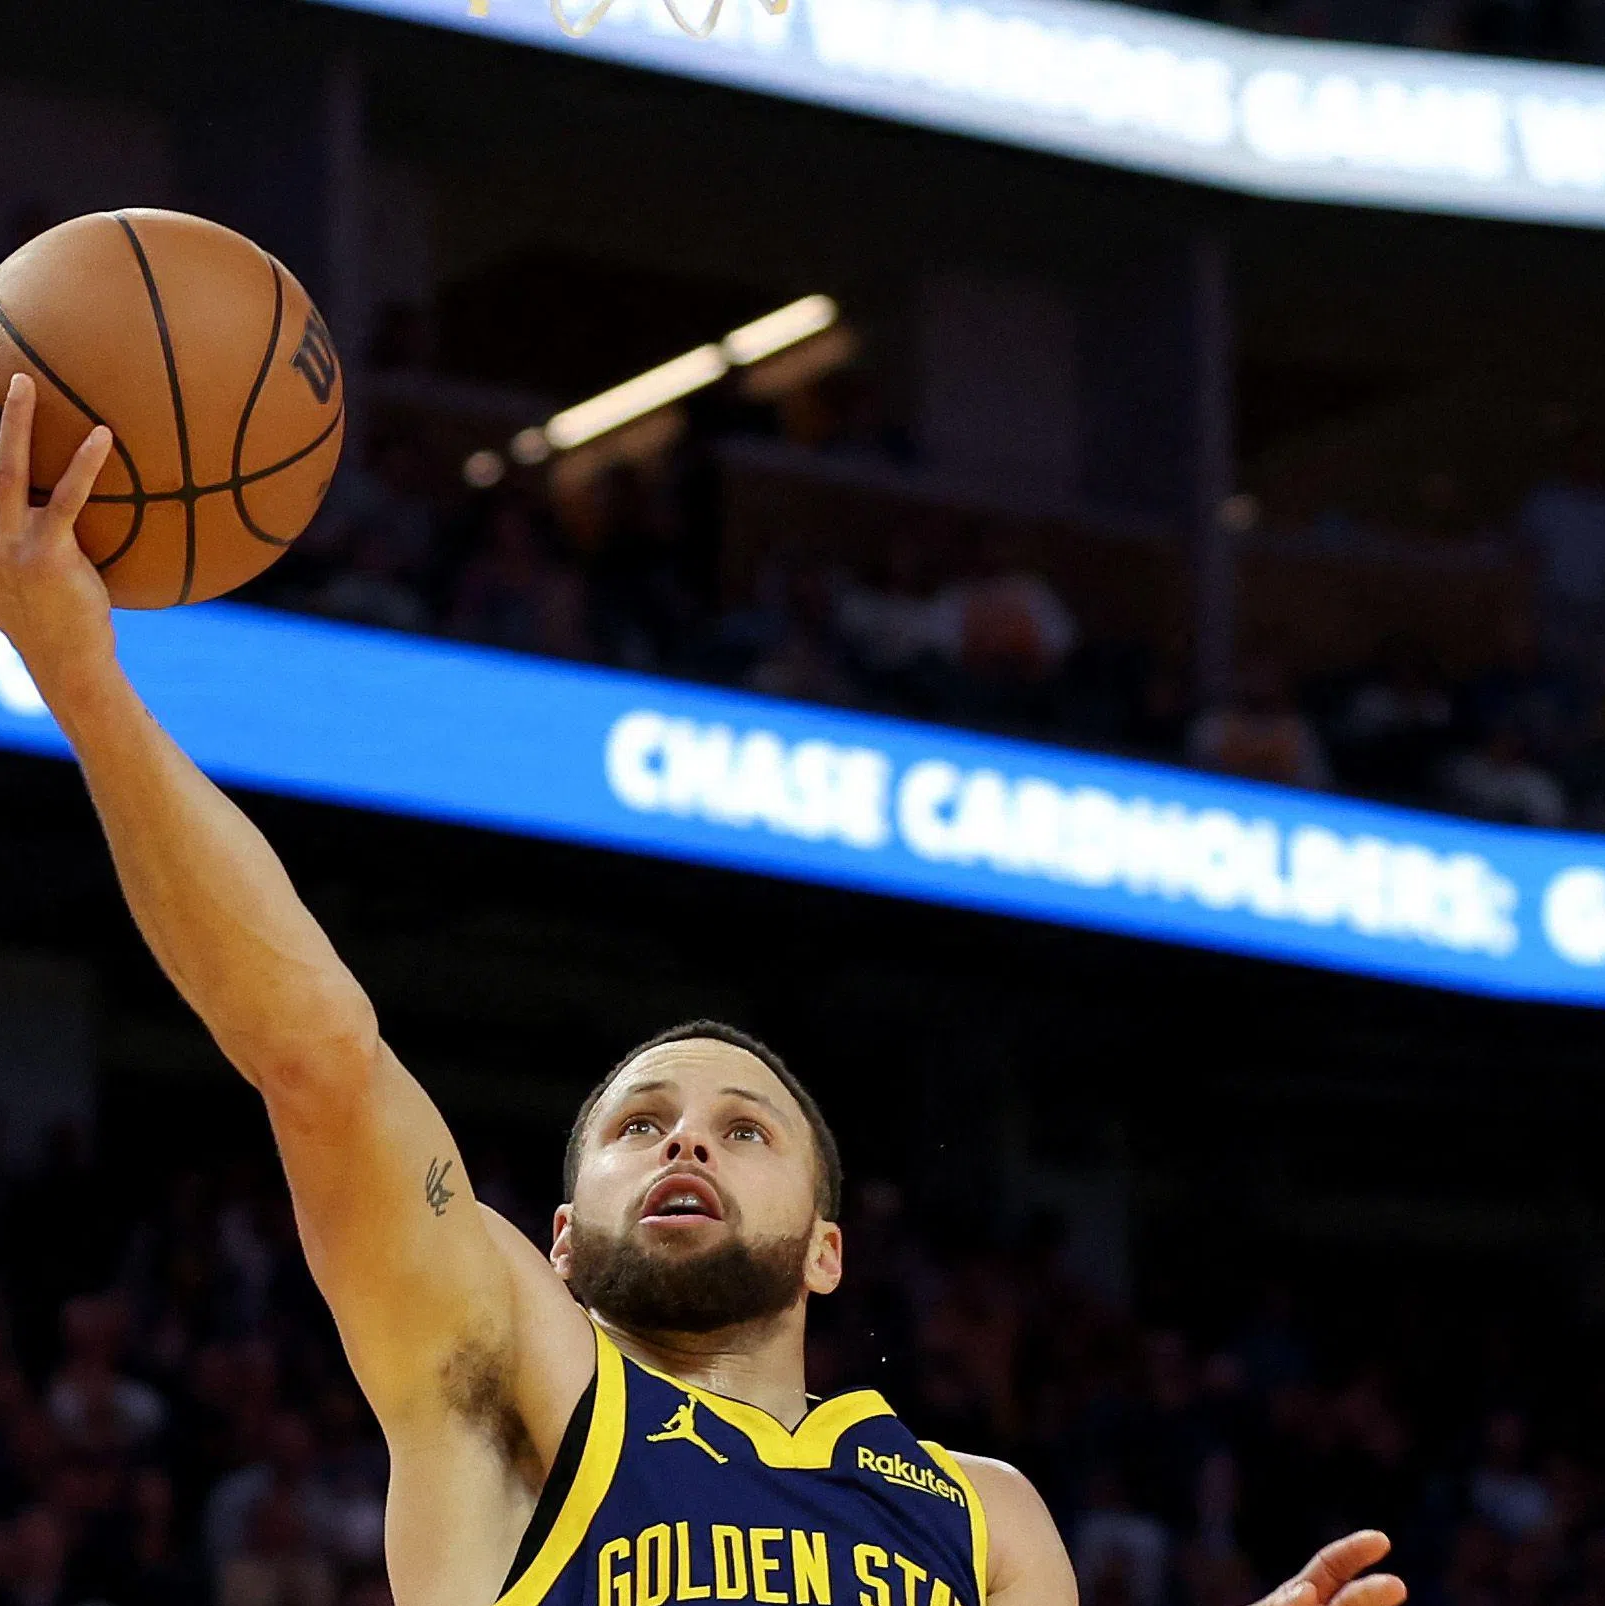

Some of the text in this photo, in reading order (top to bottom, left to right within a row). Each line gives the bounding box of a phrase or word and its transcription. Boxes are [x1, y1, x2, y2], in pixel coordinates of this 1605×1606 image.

[1242, 68, 1508, 181] GAME
[604, 710, 890, 848] CHASE
[857, 1444, 966, 1508] Rakuten
